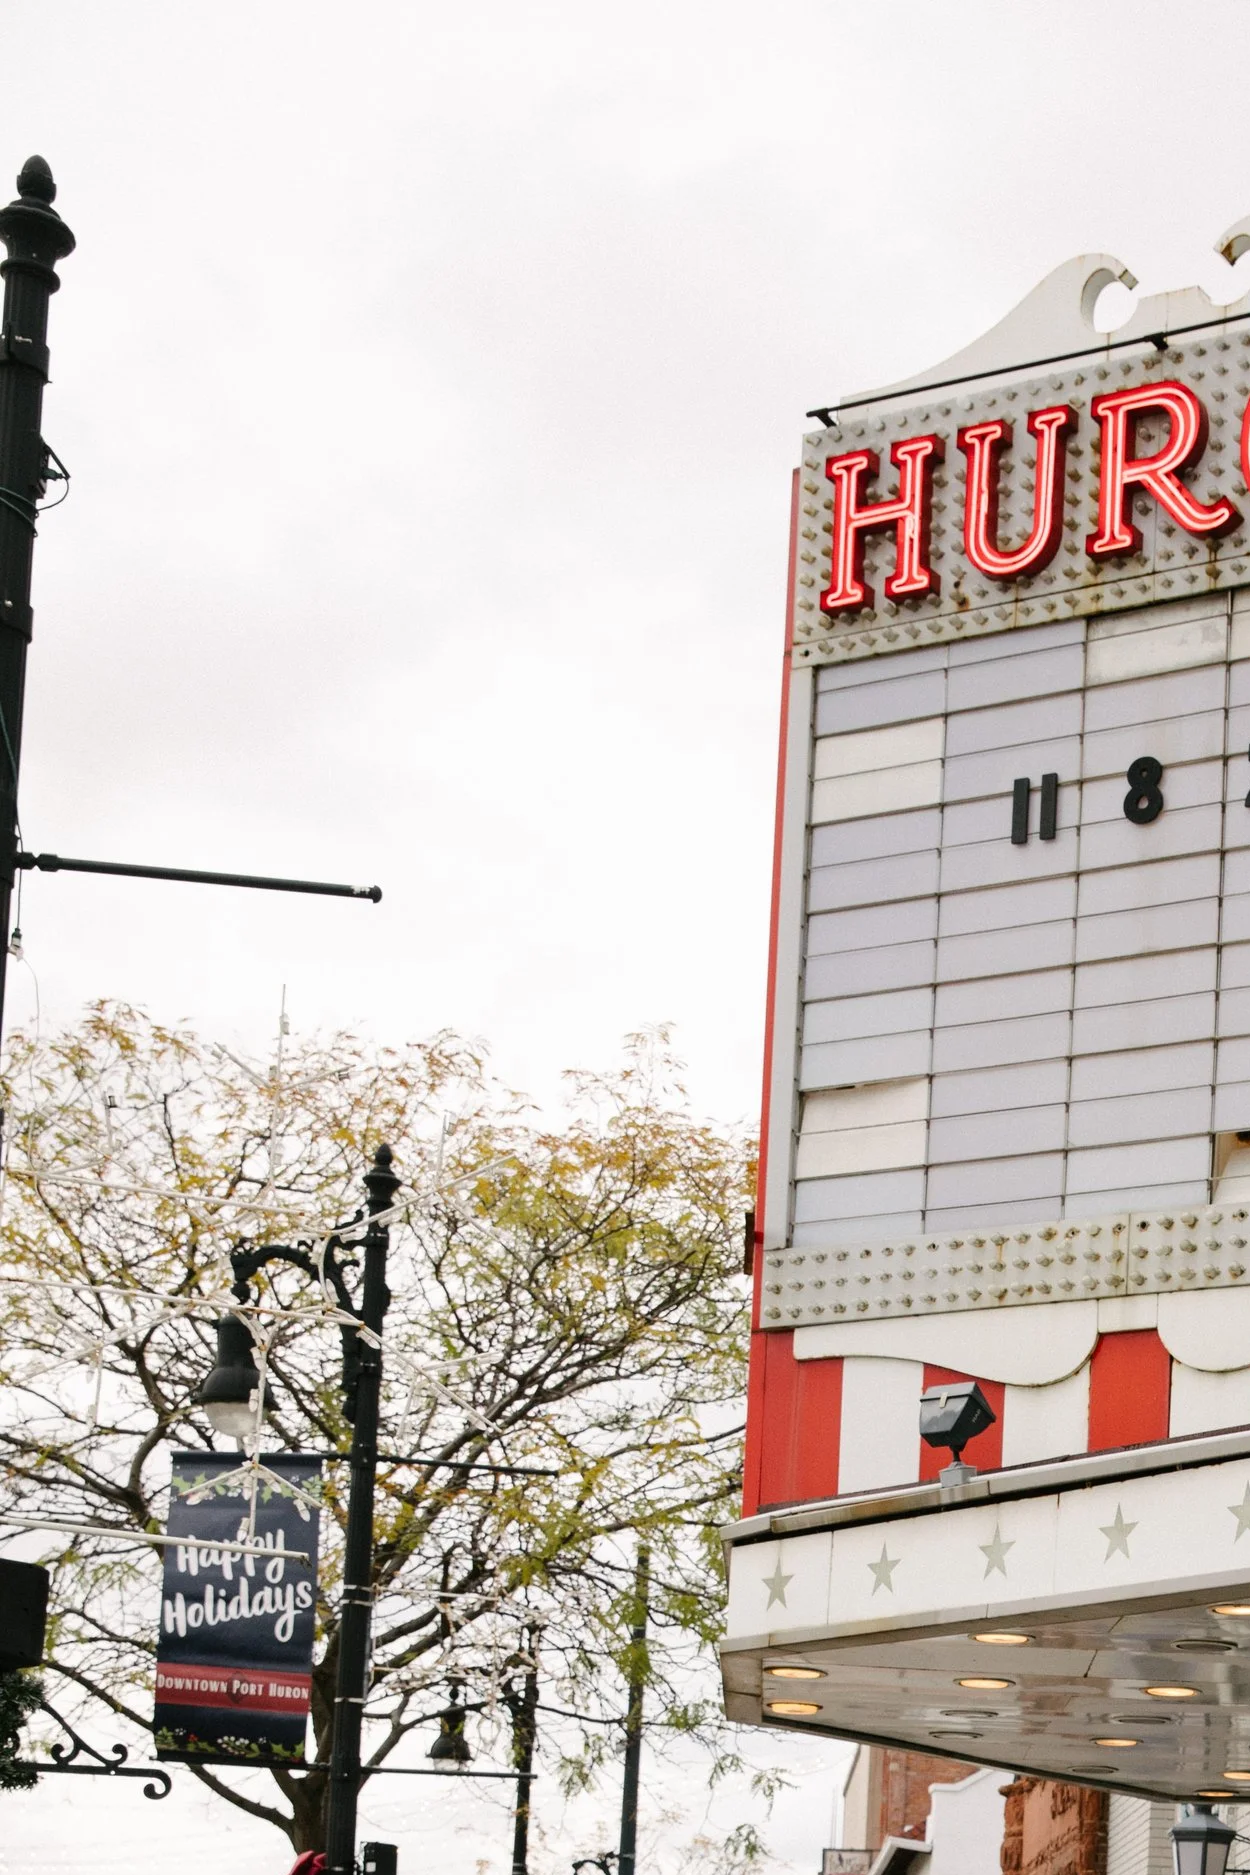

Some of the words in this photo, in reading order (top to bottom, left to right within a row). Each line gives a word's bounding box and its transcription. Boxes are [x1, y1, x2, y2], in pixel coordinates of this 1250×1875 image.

[1010, 772, 1059, 845] 11
[1123, 755, 1164, 826] 8
[176, 1528, 286, 1584] Happy
[163, 1575, 313, 1643] Holidays
